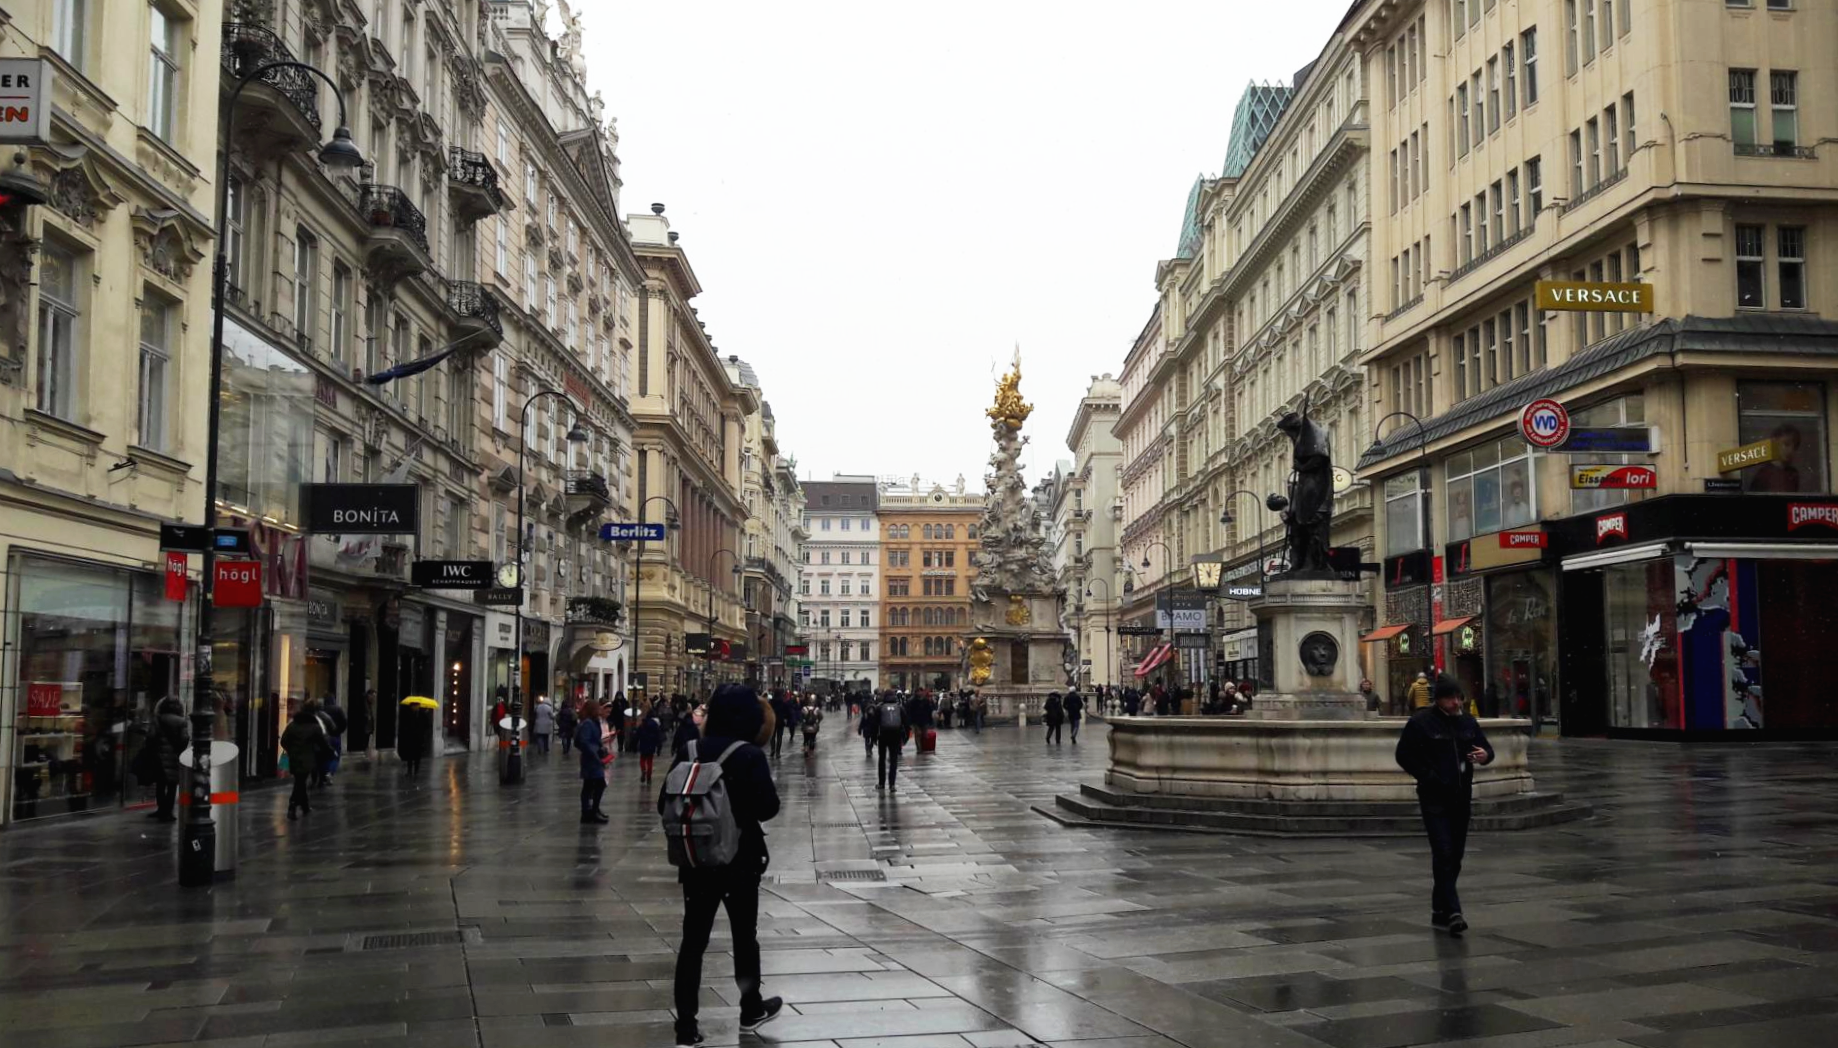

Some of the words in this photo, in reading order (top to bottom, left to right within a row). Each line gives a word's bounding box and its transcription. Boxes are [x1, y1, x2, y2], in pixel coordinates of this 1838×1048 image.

[1551, 288, 1642, 304] VERSACE
[1721, 445, 1767, 466] VERSACE
[1792, 506, 1838, 525] CAMPER
[610, 526, 658, 537] Berlitz
[1597, 516, 1624, 537] CAMPER
[1509, 534, 1540, 545] CAMPER
[219, 568, 258, 583] högl
[442, 565, 472, 578] IWC
[1161, 611, 1202, 622] BAMO
